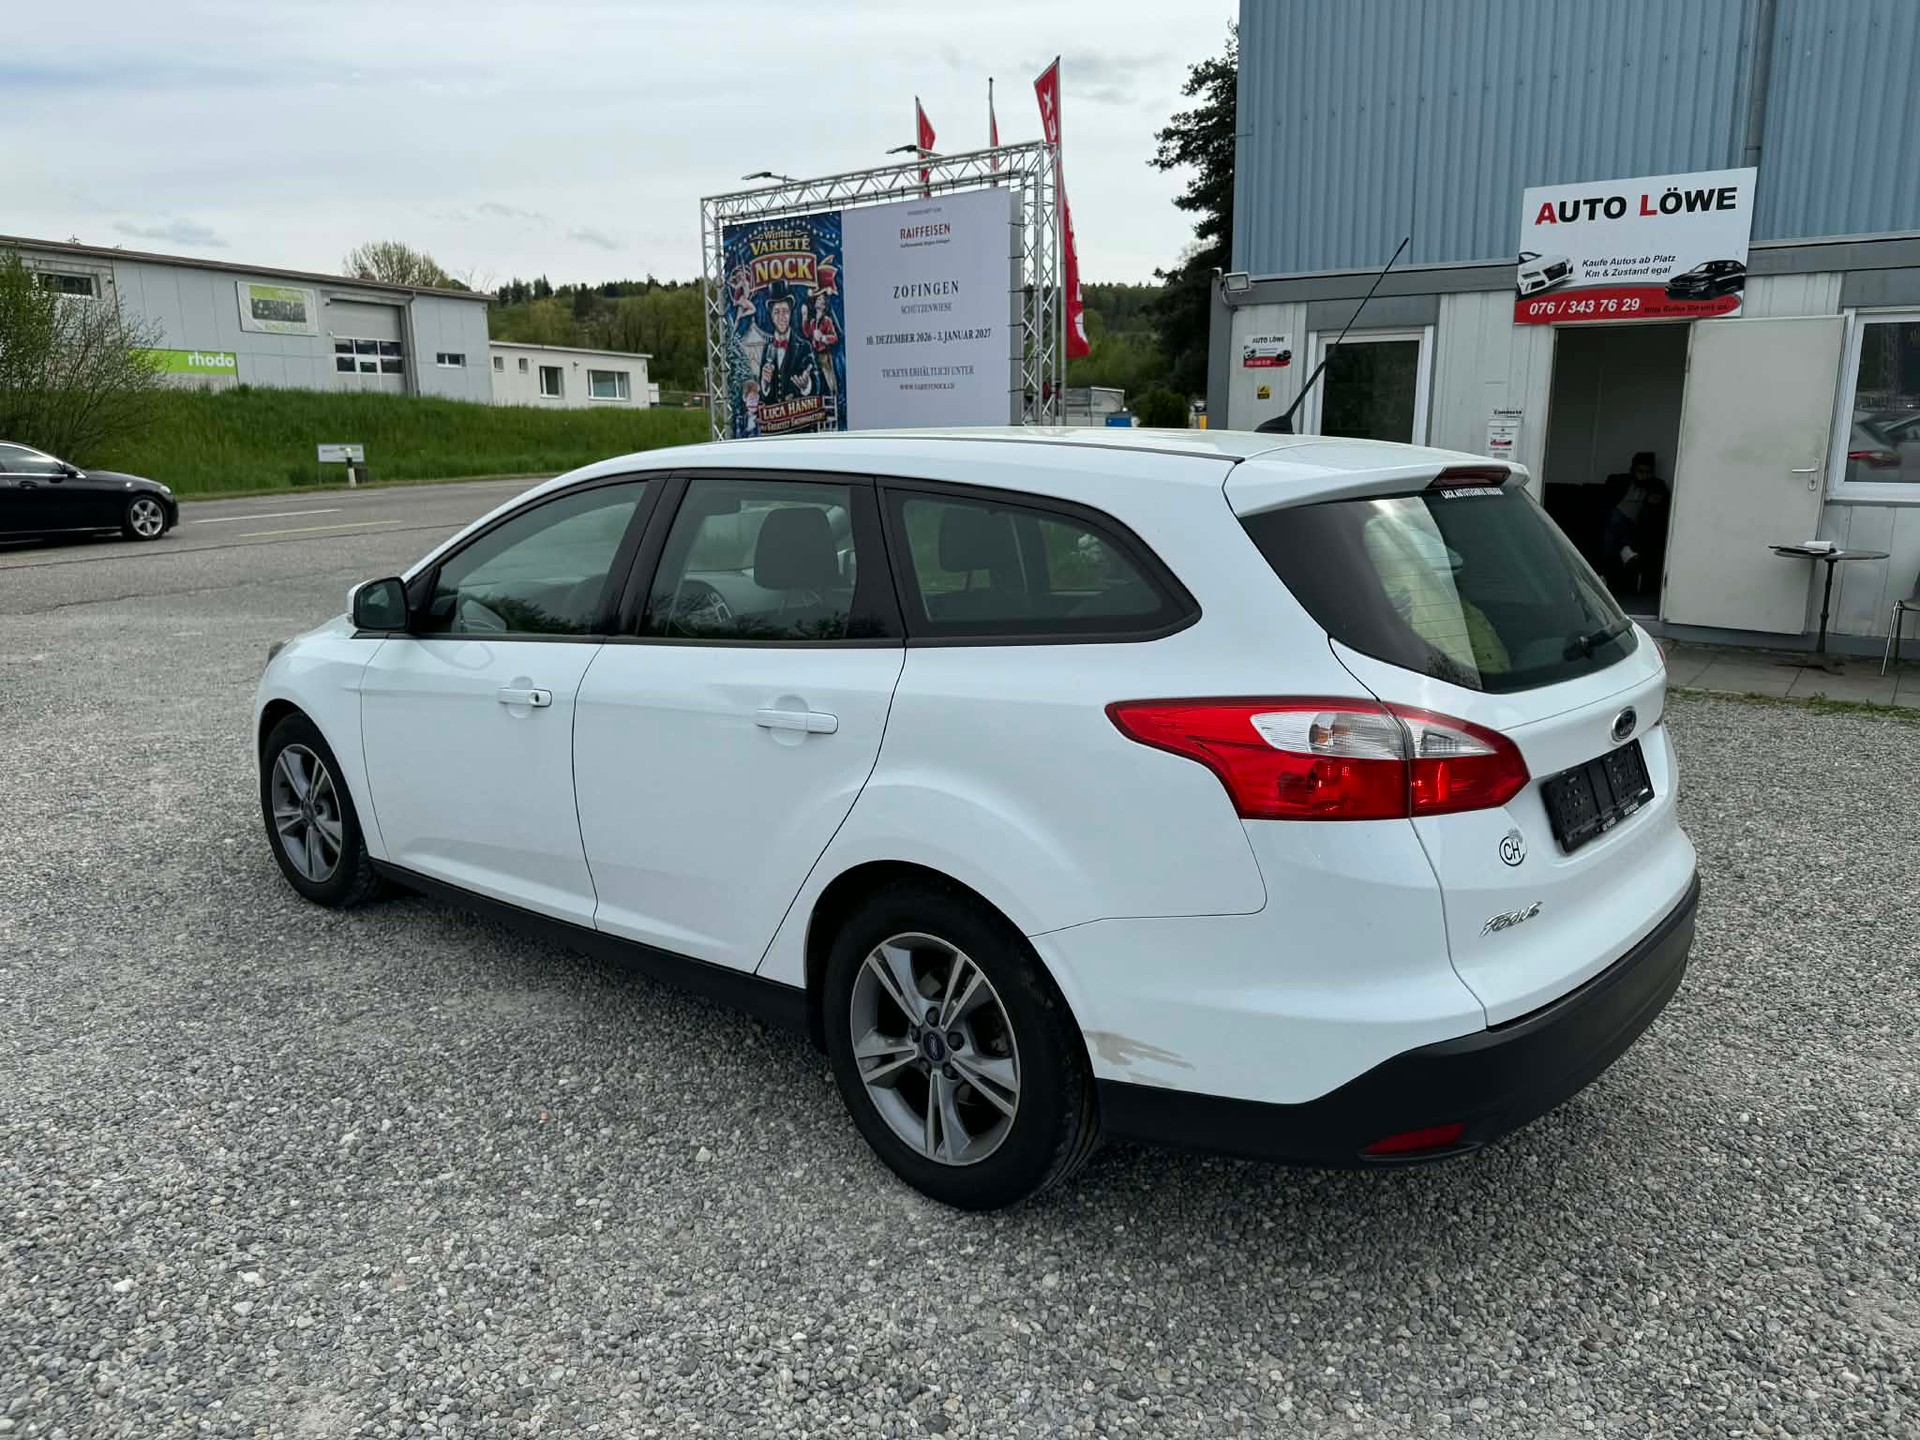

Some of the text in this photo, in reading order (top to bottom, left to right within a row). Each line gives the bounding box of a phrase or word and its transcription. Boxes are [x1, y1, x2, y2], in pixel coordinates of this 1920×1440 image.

[1534, 187, 1738, 226] AUTO LÖWE
[764, 229, 794, 241] Winter
[900, 223, 951, 240] RAIFFEISEN
[750, 235, 811, 256] VARIETÉ
[1582, 254, 1676, 268] Kaufe Autos ab Platz
[754, 258, 813, 284] NOCK
[1585, 265, 1671, 278] Km & Zustand egal
[893, 280, 959, 299] ZOFINGEN
[1529, 298, 1640, 315] 076 / 343 76 29
[876, 333, 915, 345] DEZEMBER
[917, 332, 932, 342] 2026
[943, 329, 974, 344] JANUAR
[975, 328, 991, 339] 2027
[1252, 335, 1285, 344] AUTO LÖWE
[188, 351, 235, 367] rhodo
[762, 406, 787, 421] LUCA
[1504, 841, 1521, 861] CH
